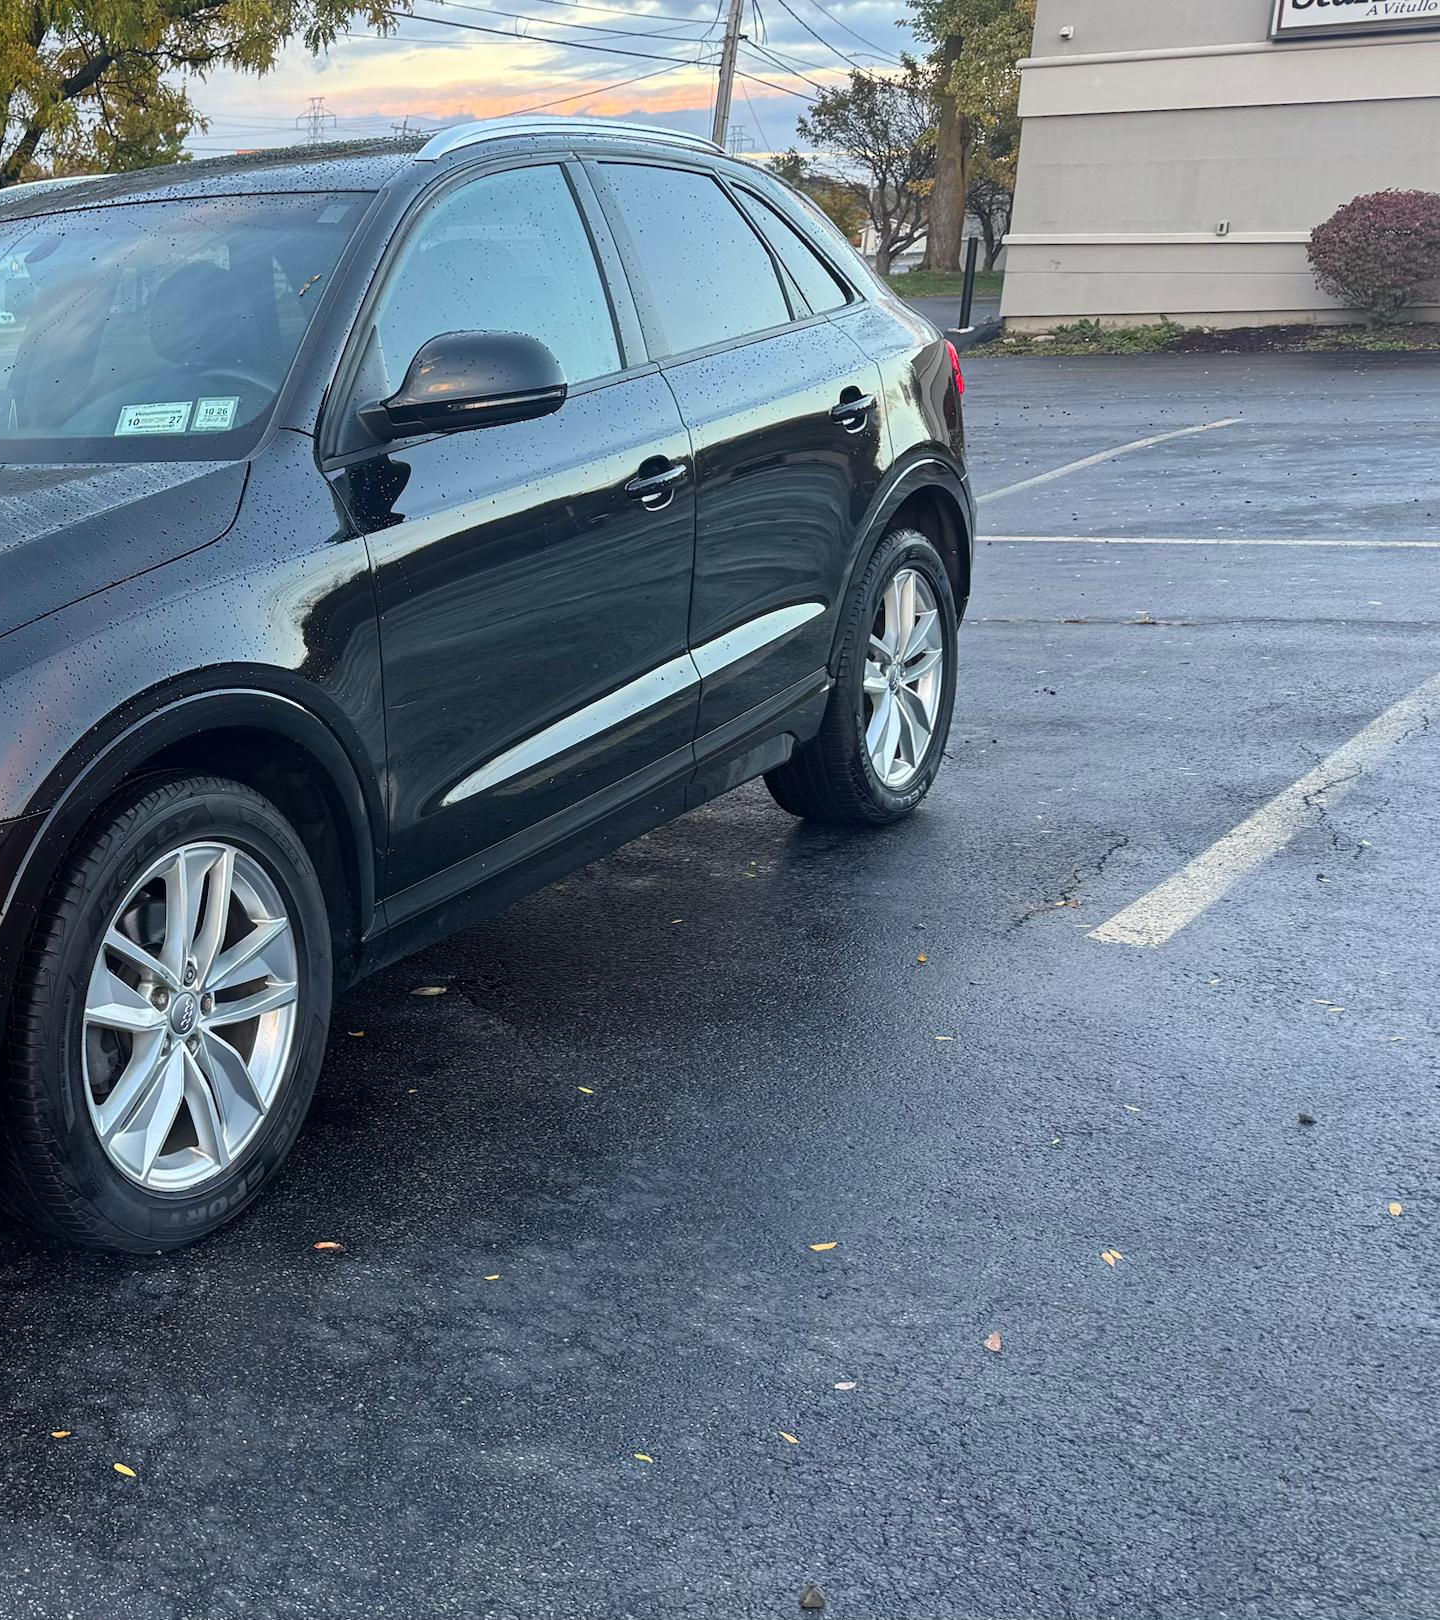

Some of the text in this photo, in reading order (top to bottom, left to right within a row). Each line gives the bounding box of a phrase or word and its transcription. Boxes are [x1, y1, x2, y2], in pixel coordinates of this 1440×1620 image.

[1366, 6, 1378, 16] A
[1384, 0, 1438, 14] Vitullo
[205, 407, 228, 415] 10 26
[128, 417, 140, 427] 10
[169, 415, 183, 424] 27
[166, 1160, 265, 1225] SPORT
